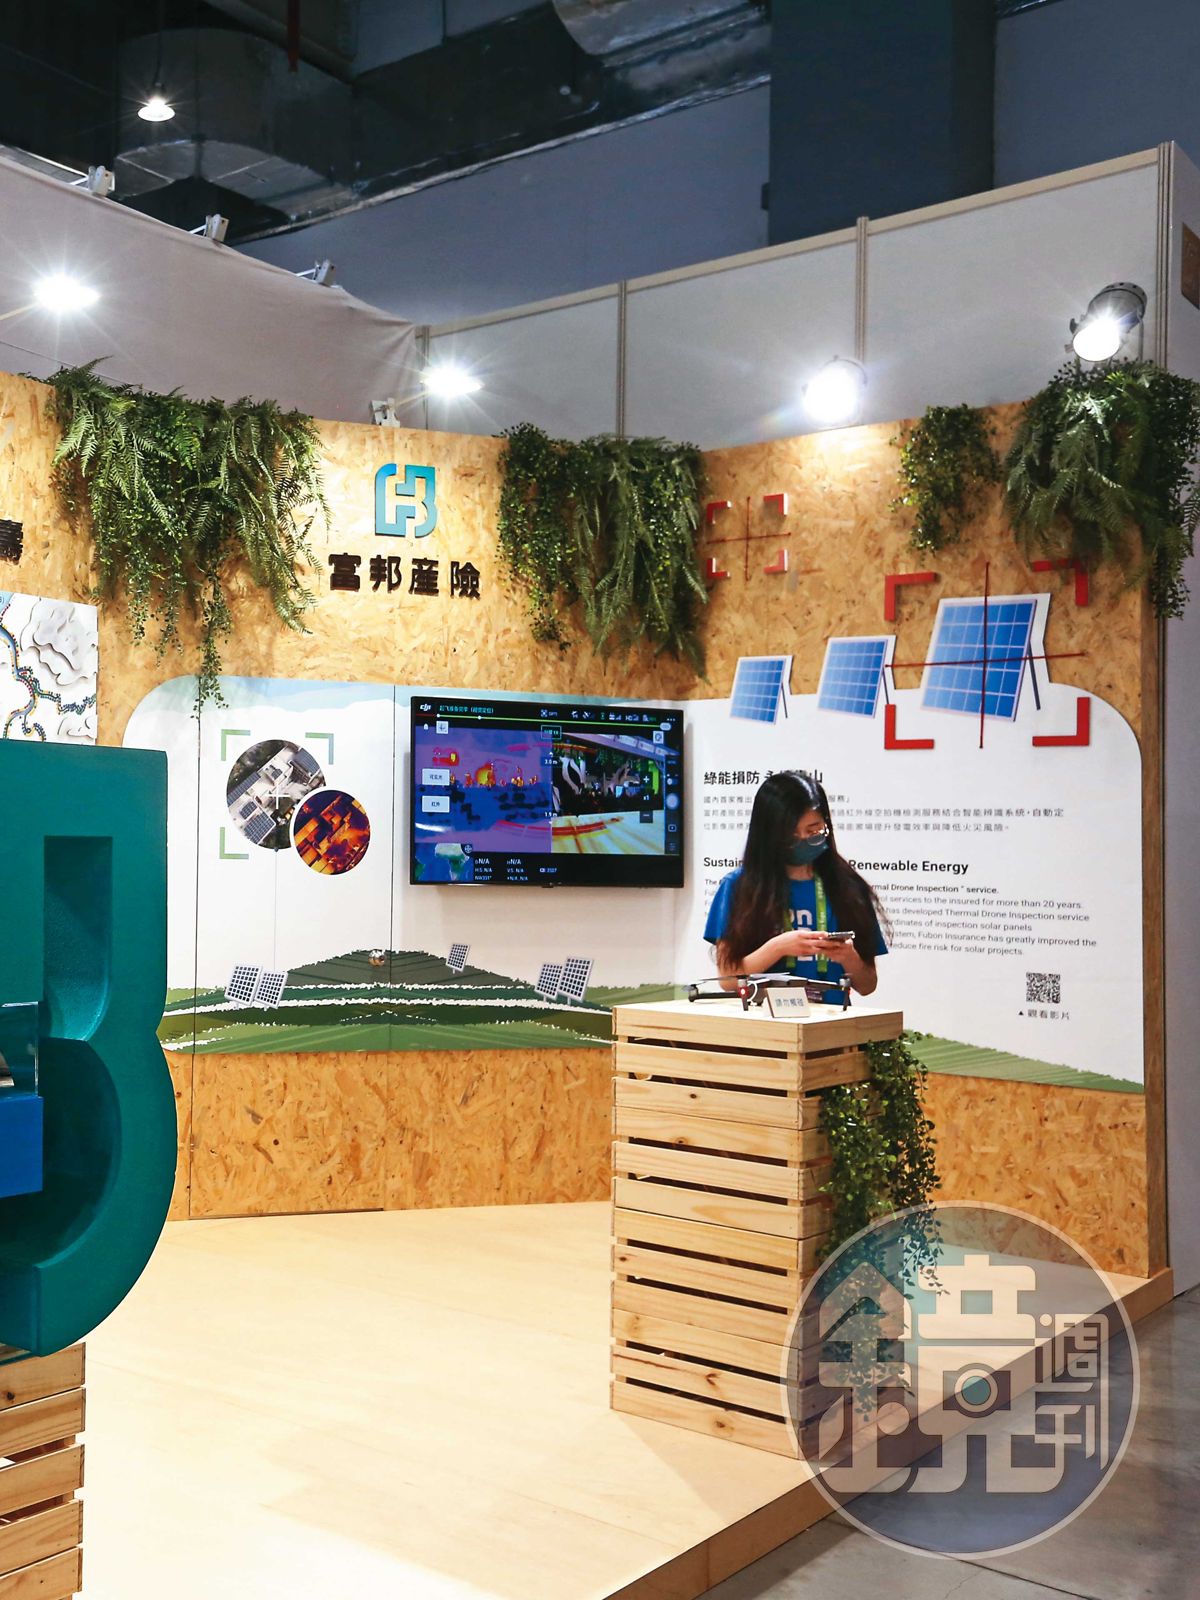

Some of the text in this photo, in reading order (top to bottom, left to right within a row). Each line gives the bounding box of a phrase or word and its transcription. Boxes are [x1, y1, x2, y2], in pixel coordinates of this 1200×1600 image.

[849, 860, 918, 871] Renewable
[921, 861, 969, 875] Energy
[873, 883, 890, 891] rmal
[916, 885, 959, 894] Inspection
[923, 896, 932, 904] to
[902, 908, 943, 916] developed
[945, 909, 979, 917] Thermal
[981, 910, 1007, 918] Drone
[1009, 911, 1055, 922] Inspection
[1057, 913, 1090, 921] service
[891, 919, 1033, 932] rdinates of inspection solar panels
[894, 931, 916, 939] stem,
[945, 933, 986, 941] Insurance
[1005, 936, 1036, 945] greatly
[1037, 938, 1080, 947] improved
[1082, 939, 1097, 947] the
[918, 942, 932, 950] fire
[934, 943, 948, 951] risk
[950, 943, 962, 951] for
[964, 945, 985, 953] solar
